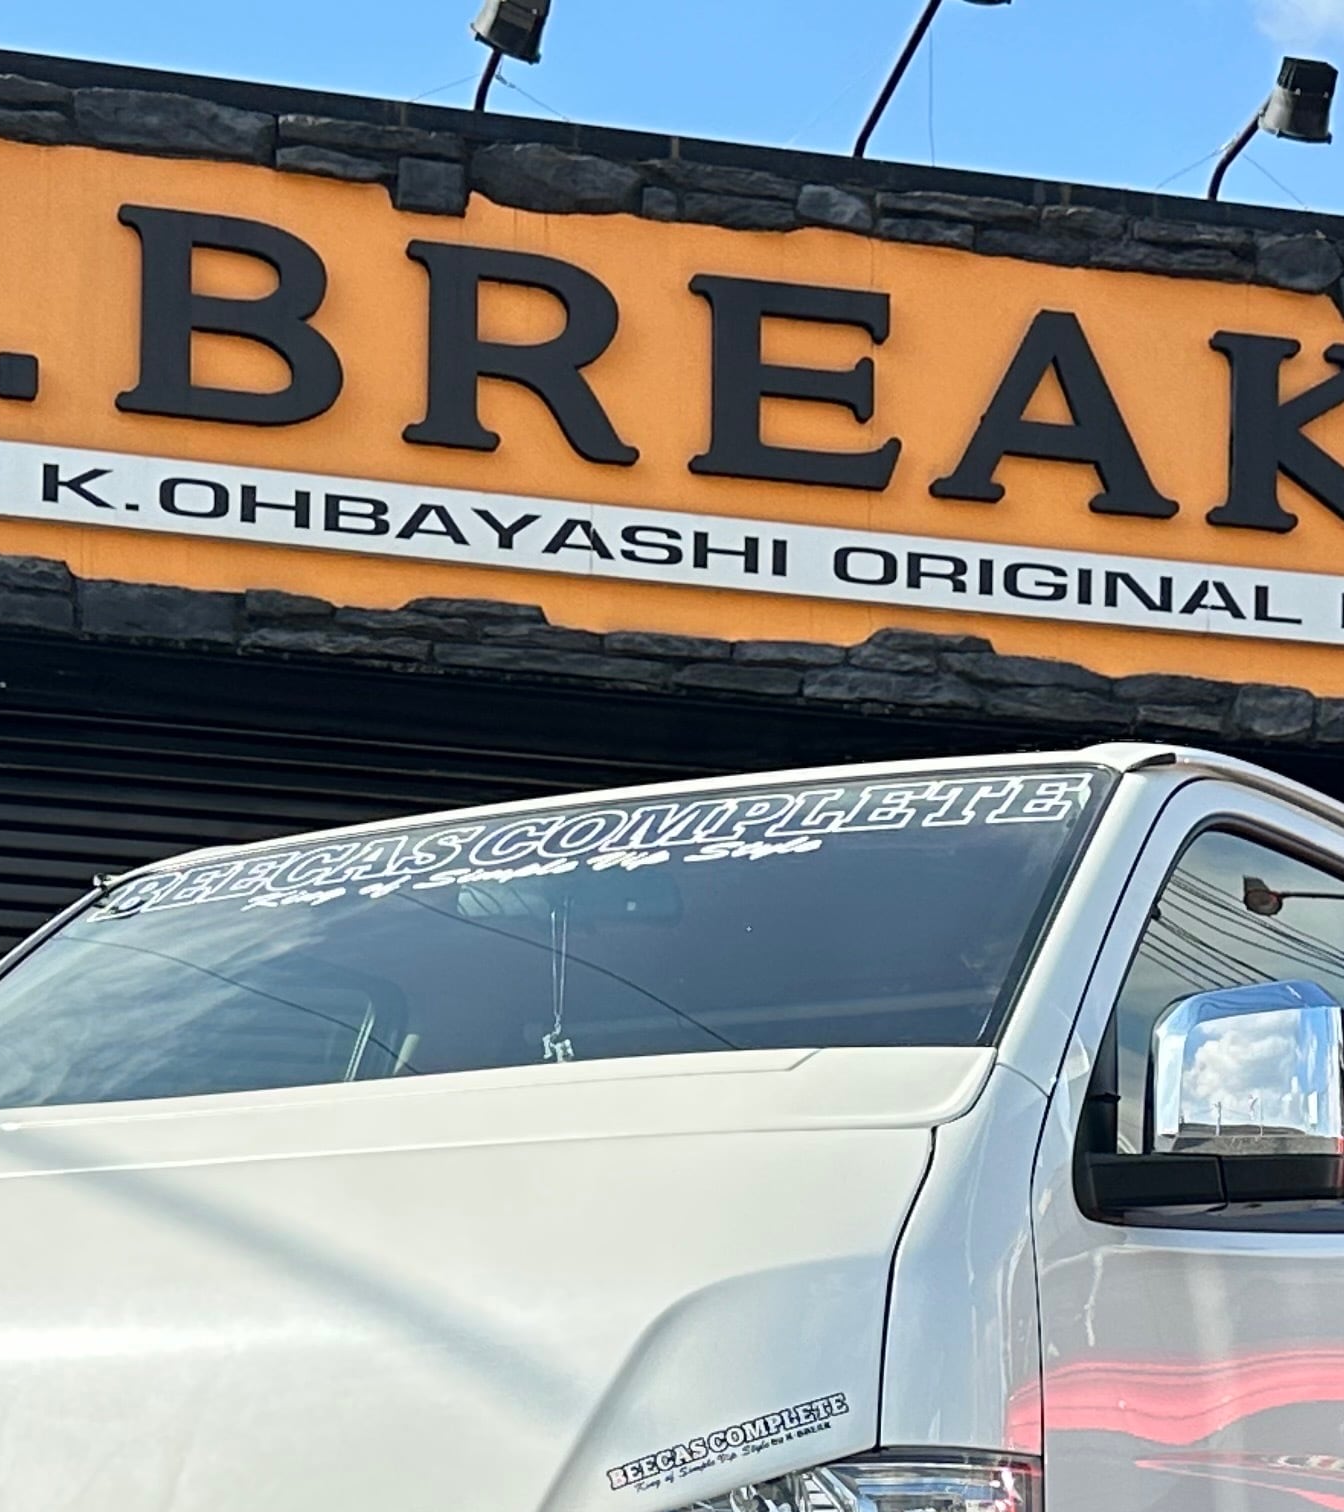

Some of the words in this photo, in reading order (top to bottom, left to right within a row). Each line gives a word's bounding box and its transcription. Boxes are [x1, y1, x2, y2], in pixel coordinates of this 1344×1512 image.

[40, 461, 789, 578] K.OHBAYASHI
[831, 545, 1304, 626] ORIGINAL
[358, 876, 408, 900] of
[413, 855, 577, 890] Simple
[684, 836, 823, 862] Style
